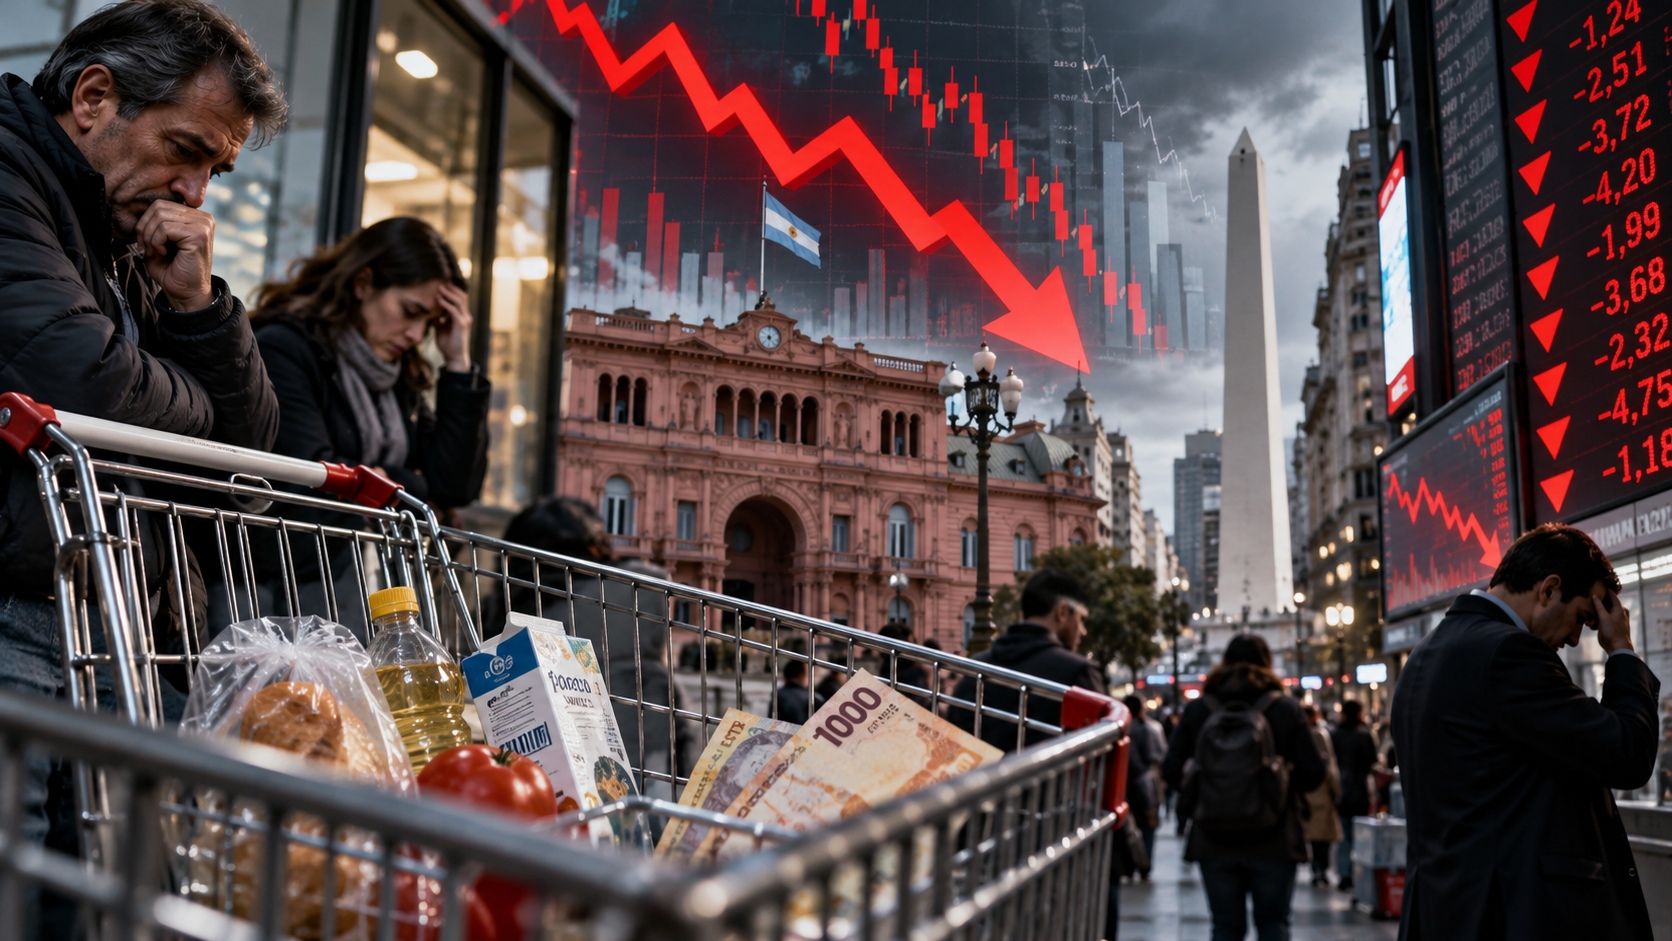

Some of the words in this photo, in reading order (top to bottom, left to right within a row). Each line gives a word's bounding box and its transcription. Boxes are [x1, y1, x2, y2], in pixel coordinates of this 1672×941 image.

[1569, 0, 1642, 51] -1,24
[1573, 41, 1647, 99] -2,51
[1578, 93, 1652, 154] -3,72
[1582, 148, 1656, 205] -4,20
[1586, 202, 1660, 260] -1,99
[1590, 257, 1666, 316] -3,68
[1594, 312, 1671, 372] -2,32
[1597, 368, 1672, 426] -4,75
[1602, 427, 1672, 484] -1,18
[812, 686, 882, 748] 1000
